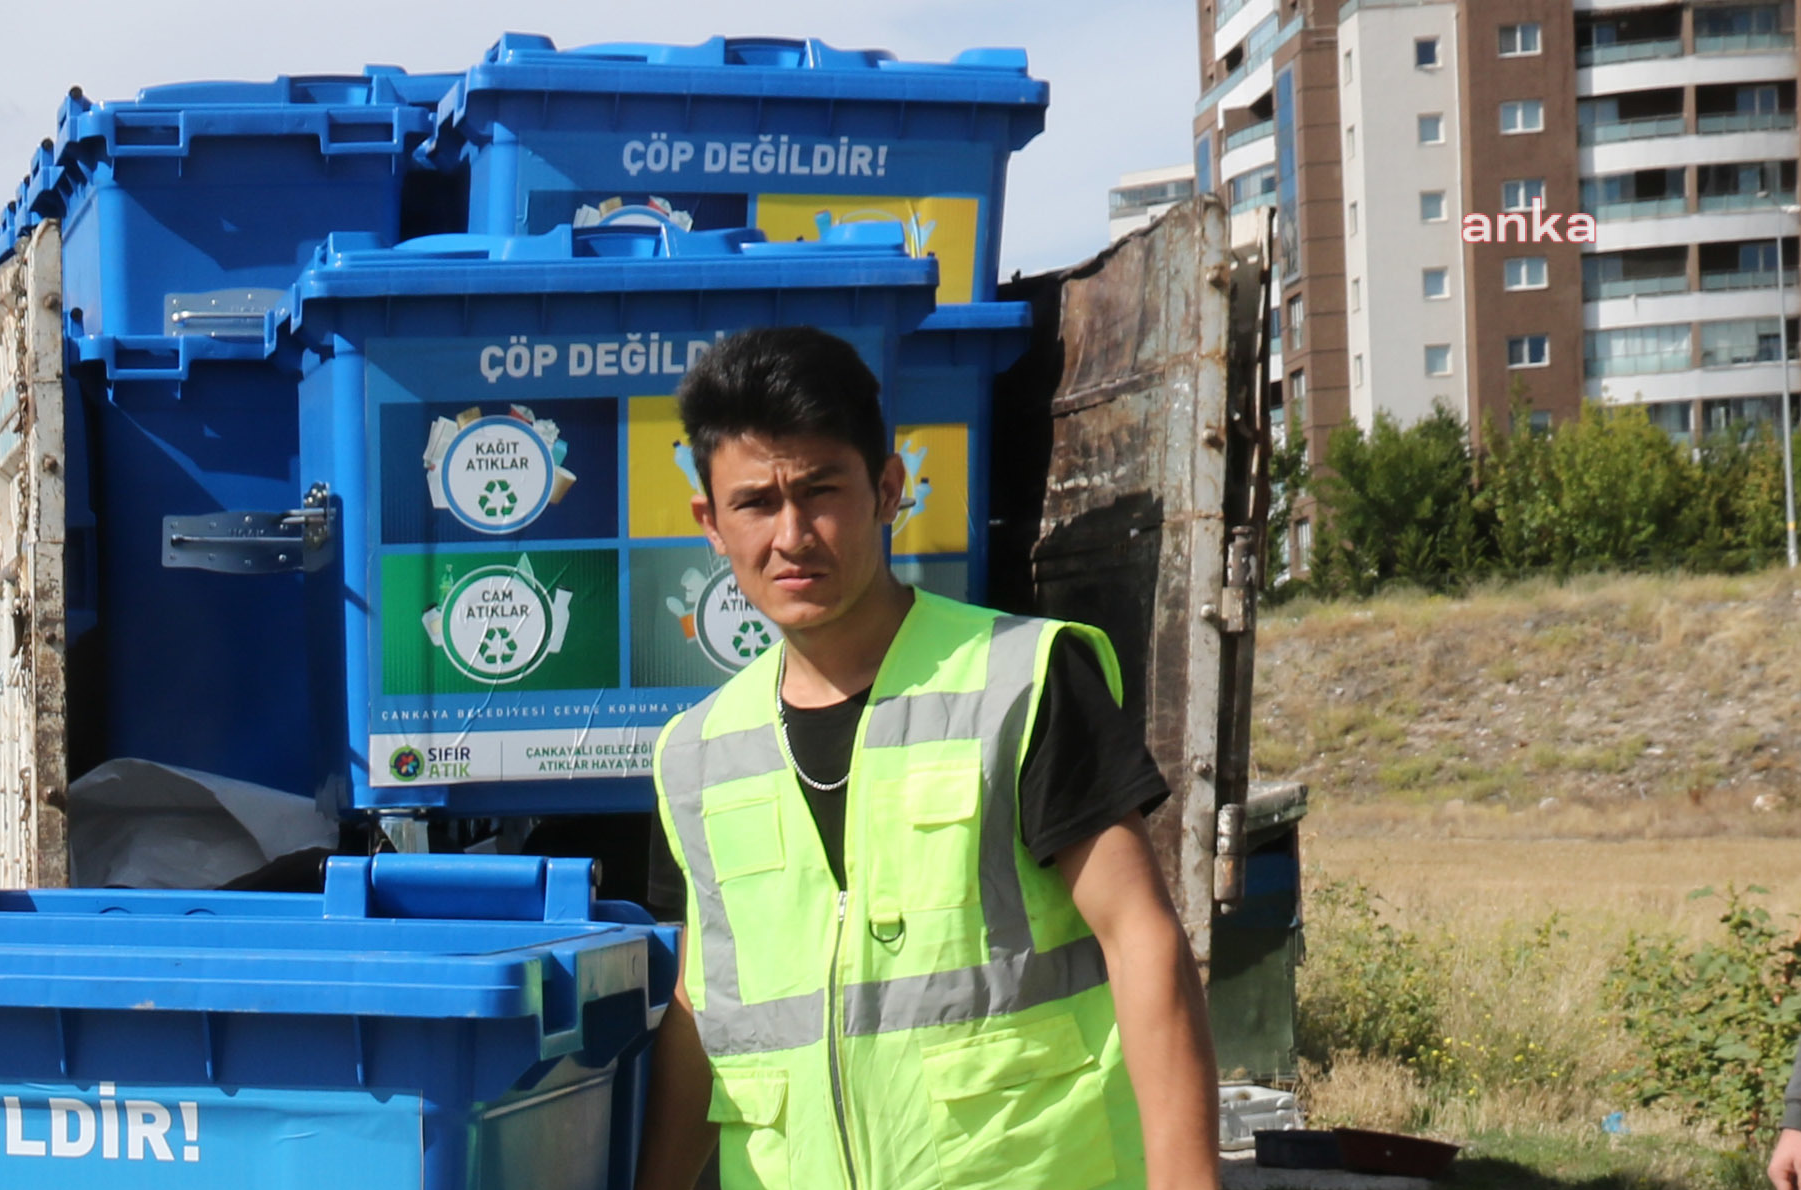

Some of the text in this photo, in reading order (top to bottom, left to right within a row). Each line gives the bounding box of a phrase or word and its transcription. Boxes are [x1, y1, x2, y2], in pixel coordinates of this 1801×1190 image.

[622, 132, 888, 177] ÇÖP DEĞİLDİR!
[480, 335, 557, 383] ÇÖP
[475, 438, 519, 455] KAĞIT
[465, 456, 529, 472] ATIKLAR
[482, 589, 513, 603] CAM
[466, 604, 529, 620] ATIKLAR
[382, 709, 448, 721] ÇANKAYA
[609, 702, 668, 714] KORUMA
[428, 746, 470, 762] SIFIR
[526, 745, 592, 759] ÇANKAYALI
[428, 763, 470, 778] ATIK
[539, 759, 588, 772] ATIKLAR
